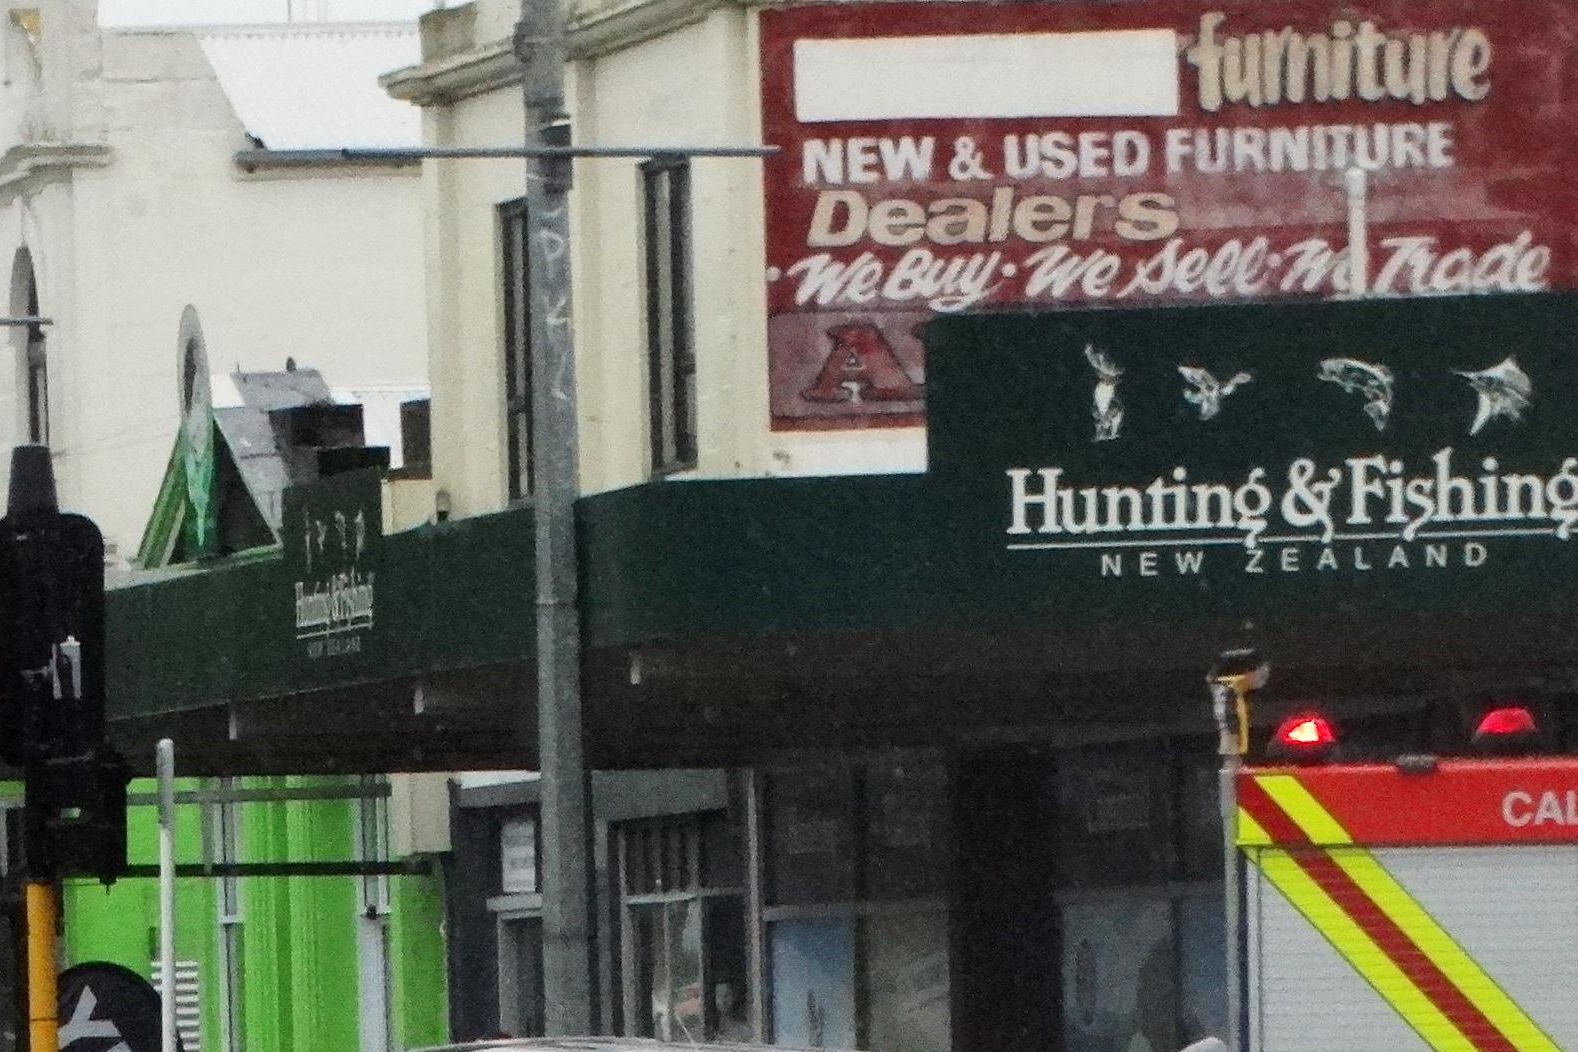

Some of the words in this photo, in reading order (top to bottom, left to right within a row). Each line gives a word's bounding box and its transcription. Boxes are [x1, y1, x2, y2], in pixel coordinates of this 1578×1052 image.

[1187, 11, 1492, 112] furniture
[802, 137, 933, 185] NEW
[948, 138, 994, 179] &
[1005, 131, 1151, 177] USED
[1166, 121, 1456, 174] FURNITURE
[807, 187, 1180, 247] Dealers
[787, 252, 883, 306] We
[883, 248, 1001, 312] Buy
[1024, 245, 1119, 299] We
[1007, 465, 1273, 548] Hunting
[1281, 457, 1340, 542] &
[1346, 446, 1578, 542] Fishing
[1101, 551, 1206, 577] NEW
[1244, 545, 1488, 574] ZEALAND
[1502, 790, 1578, 828] CAL
